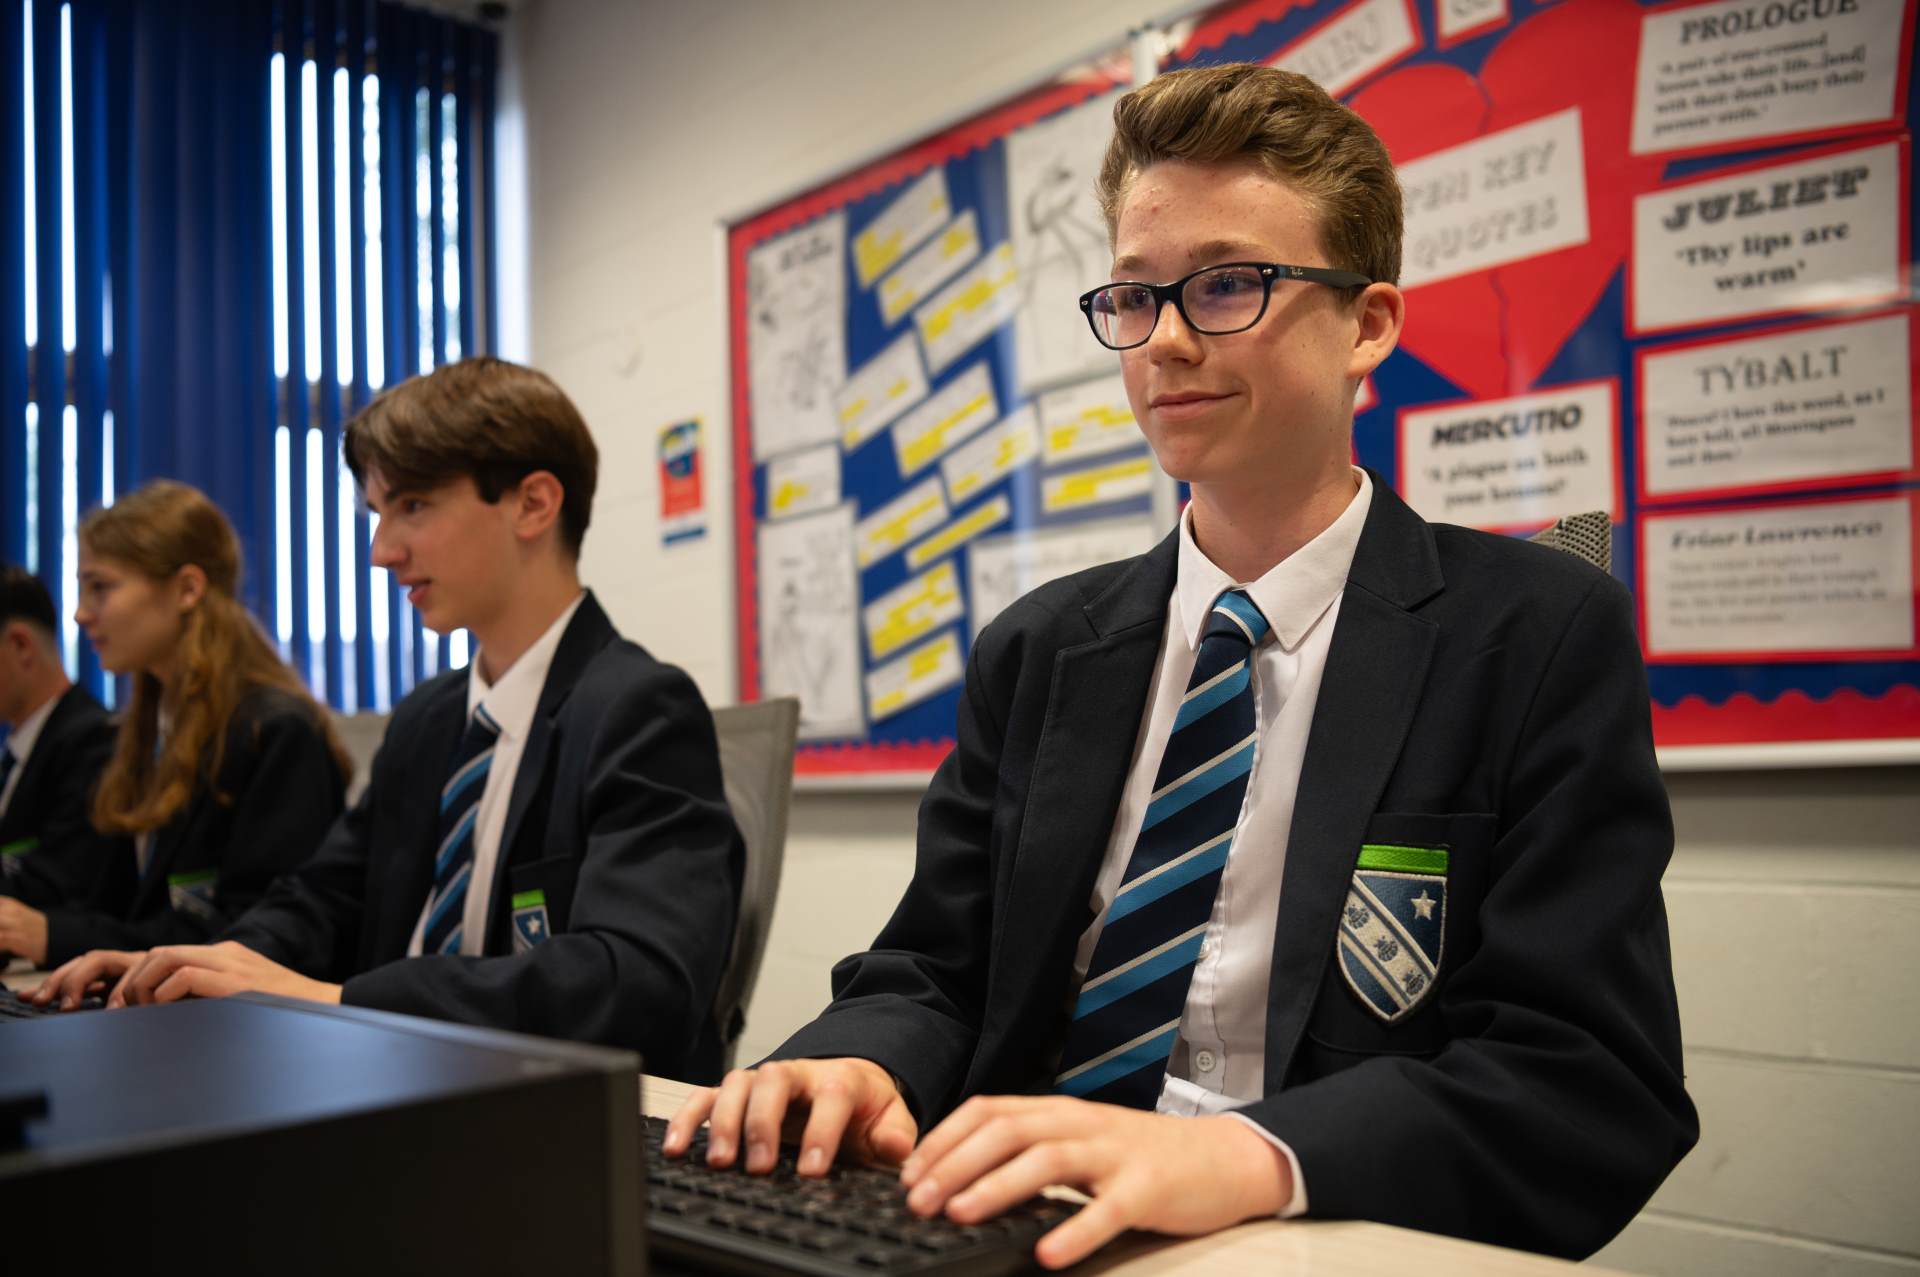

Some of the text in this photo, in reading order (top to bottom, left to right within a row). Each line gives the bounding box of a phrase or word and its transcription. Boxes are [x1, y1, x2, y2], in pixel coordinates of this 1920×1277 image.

[1679, 0, 1861, 45] PROLOGUE
[1661, 164, 1870, 232] JULIET
[1742, 231, 1793, 258] lips
[1802, 222, 1849, 246] are
[1694, 345, 1849, 397] TYBALT
[1431, 404, 1583, 447] MERCUTIO
